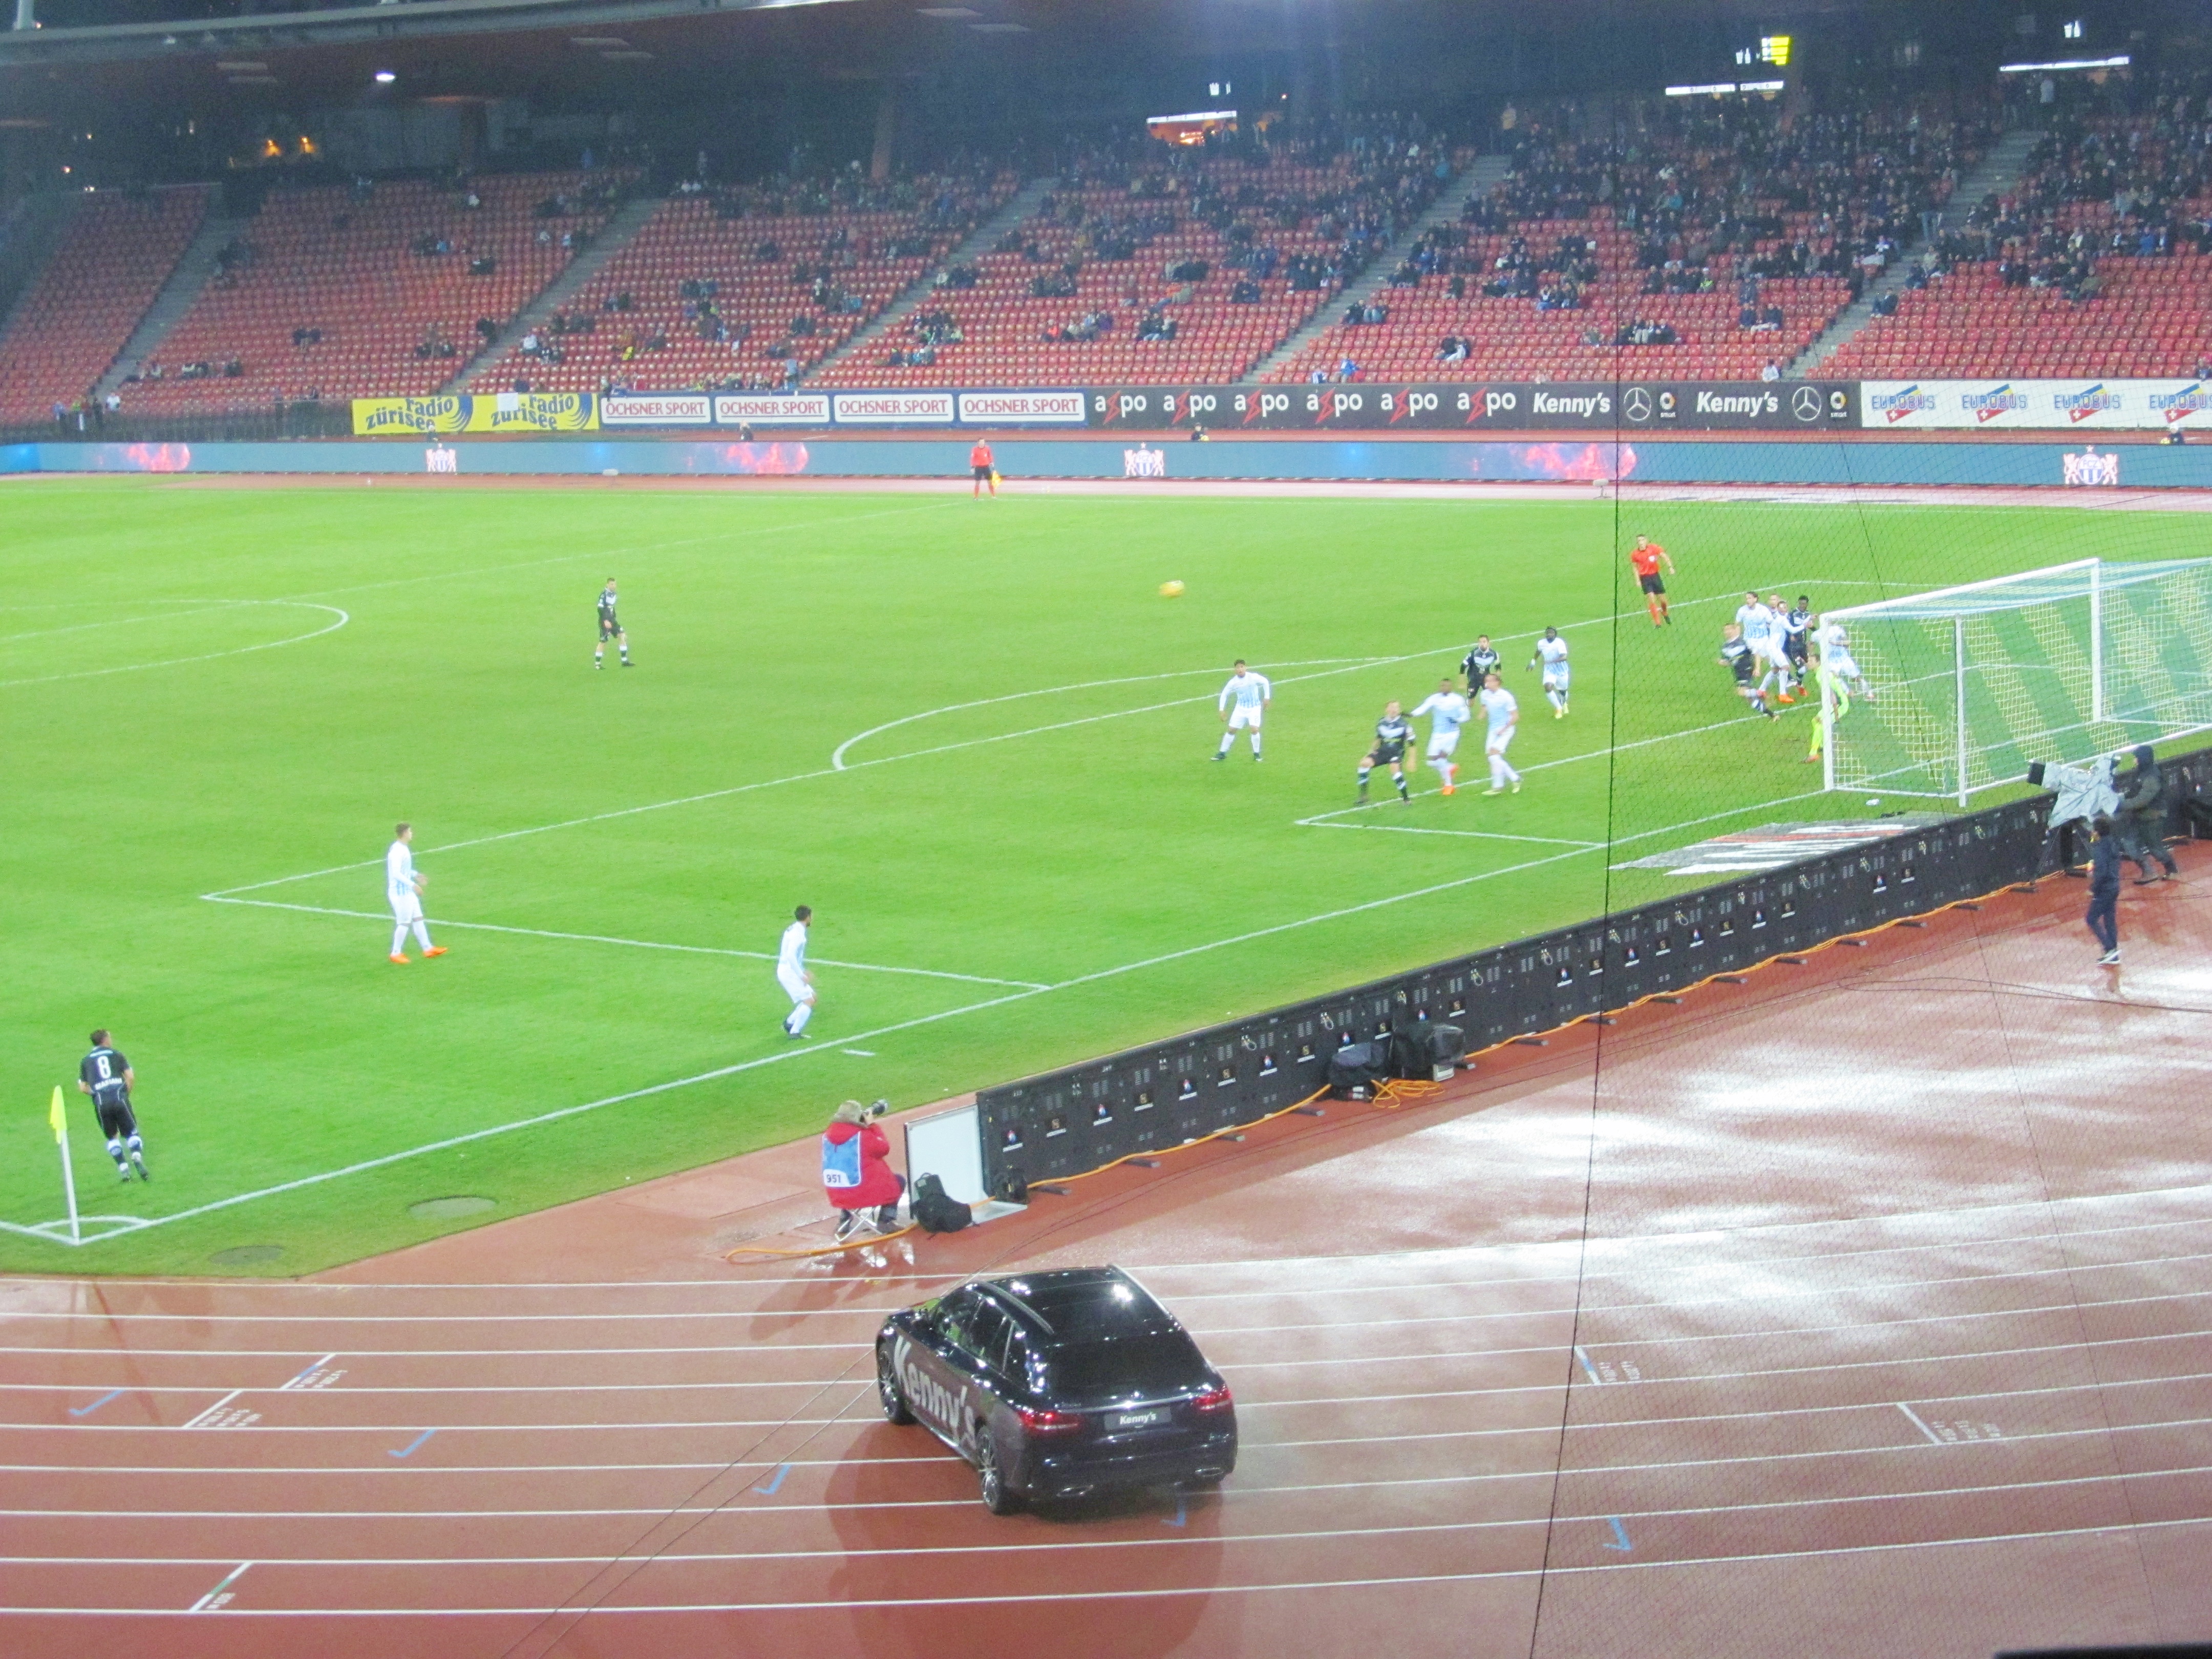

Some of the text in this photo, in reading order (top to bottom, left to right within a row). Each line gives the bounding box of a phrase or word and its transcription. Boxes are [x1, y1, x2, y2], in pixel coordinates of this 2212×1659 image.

[406, 397, 453, 417] radio
[529, 393, 574, 414] radio
[606, 401, 705, 415] OCHSNER SPORT
[720, 401, 824, 414] OCHSNER SPORT
[839, 399, 948, 413] OCHSNER SPORT
[964, 398, 1079, 413] OCHSNER SPORT
[1533, 392, 1611, 417] Kenny's
[1696, 391, 1779, 417] Kenny's
[1872, 395, 1936, 410] EUROBUS
[1962, 394, 2028, 410] EUROBUS
[2054, 394, 2121, 409] EUROBUS
[98, 1056, 111, 1079] 8
[826, 1174, 841, 1183] 951
[894, 1335, 976, 1450] Kenny's
[1119, 1412, 1156, 1425] Kenny's
